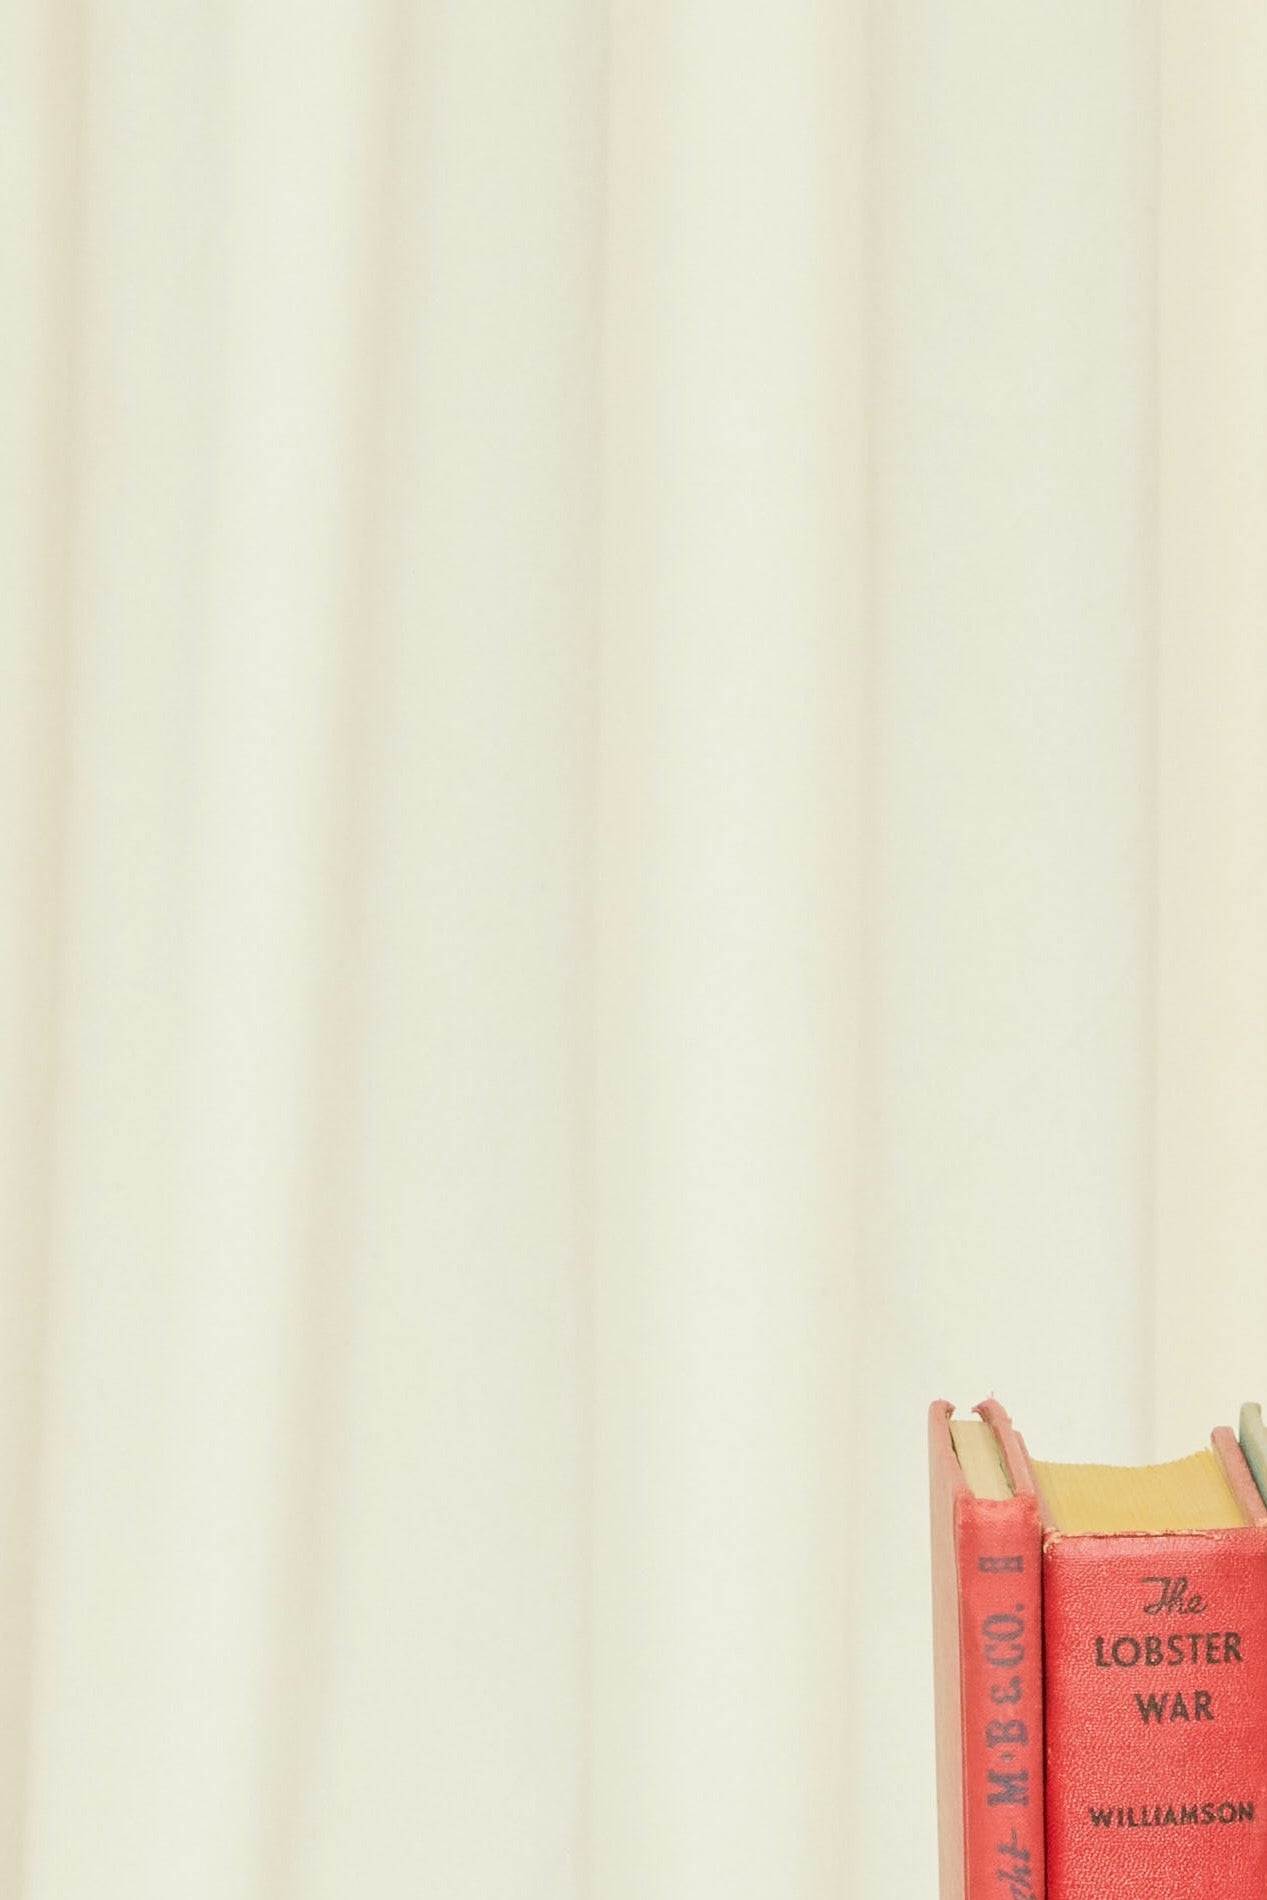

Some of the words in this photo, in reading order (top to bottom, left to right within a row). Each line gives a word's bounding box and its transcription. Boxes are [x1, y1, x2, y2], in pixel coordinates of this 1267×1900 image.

[1142, 1576, 1207, 1616] The
[982, 1603, 1026, 1669] CO.
[1094, 1632, 1244, 1668] LOBSTER
[1134, 1690, 1214, 1725] WAR
[1088, 1802, 1256, 1829] WILLIAMSON
